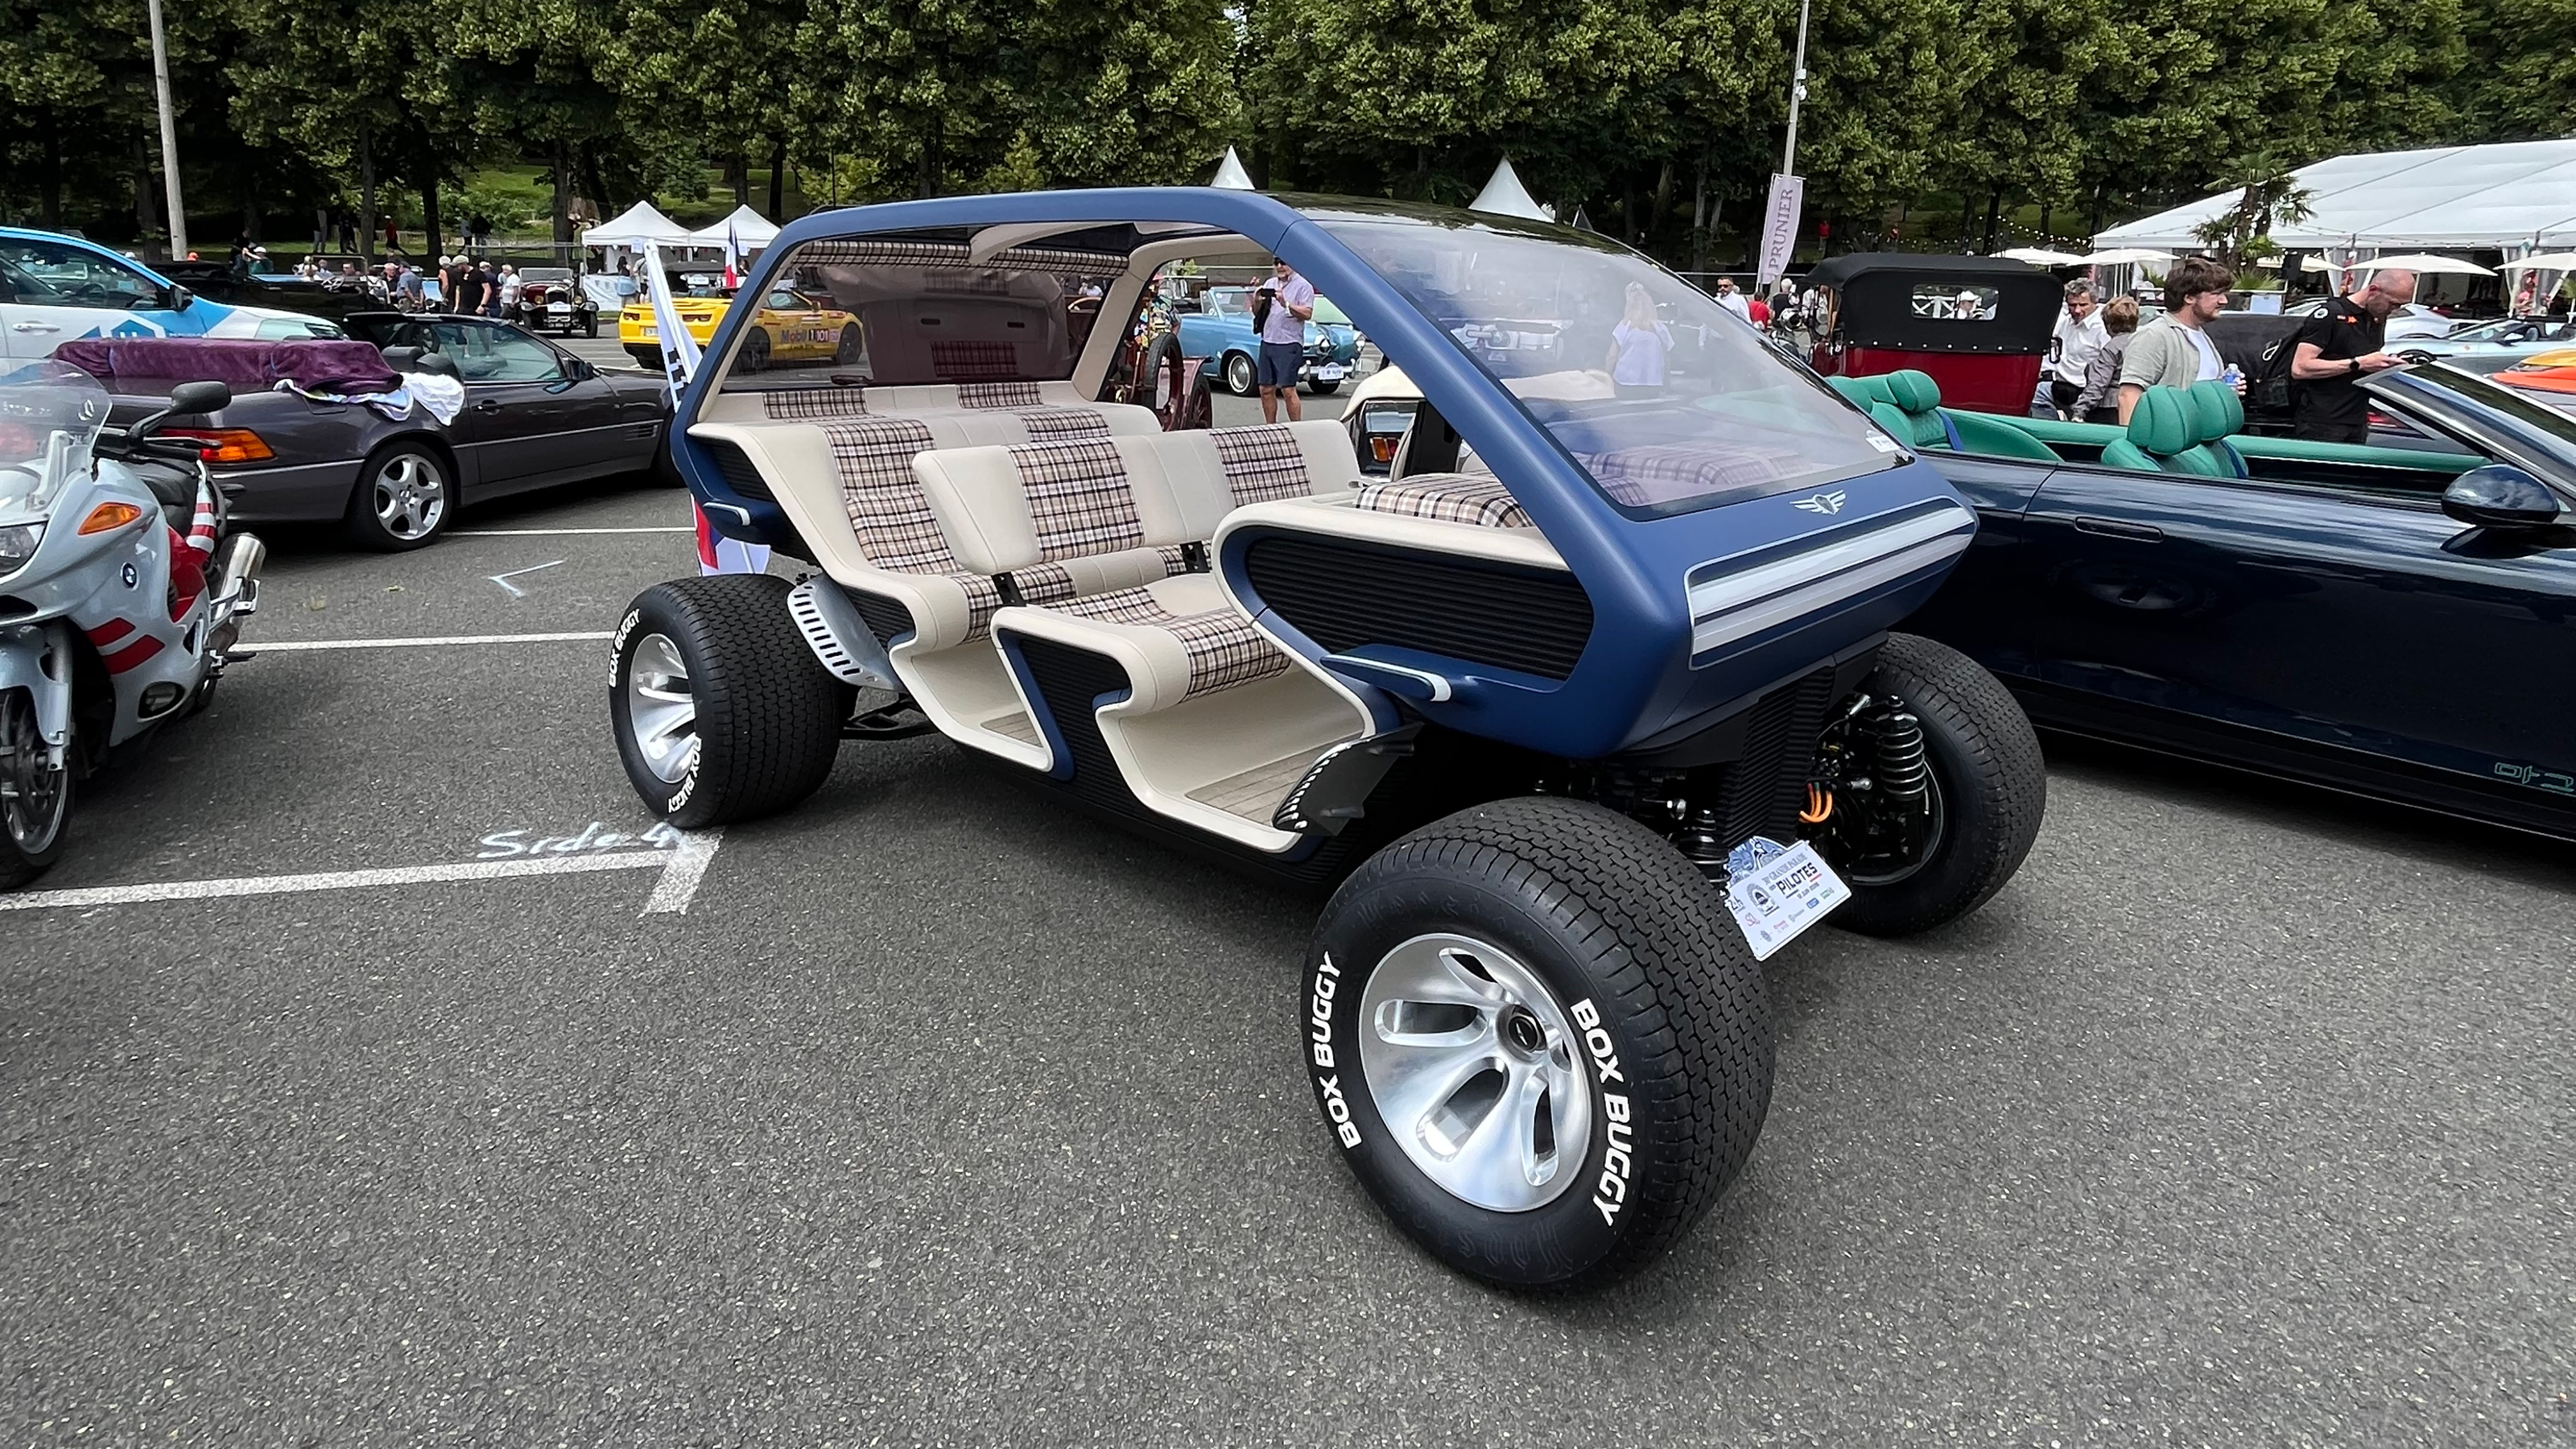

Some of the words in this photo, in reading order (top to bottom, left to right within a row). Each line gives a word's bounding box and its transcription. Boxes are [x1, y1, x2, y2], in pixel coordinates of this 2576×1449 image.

[1768, 188, 1794, 270] PRUNIER
[614, 608, 641, 651] BUGGY
[609, 648, 621, 687] BOX
[689, 736, 702, 778] BOX
[668, 774, 696, 814] BUGGY
[1776, 861, 1818, 896] PILOTES
[1311, 951, 1343, 1068] BUGGY
[1570, 997, 1624, 1084] BOX
[1319, 1074, 1363, 1150] BOX
[1592, 1092, 1634, 1227] BUGGY
